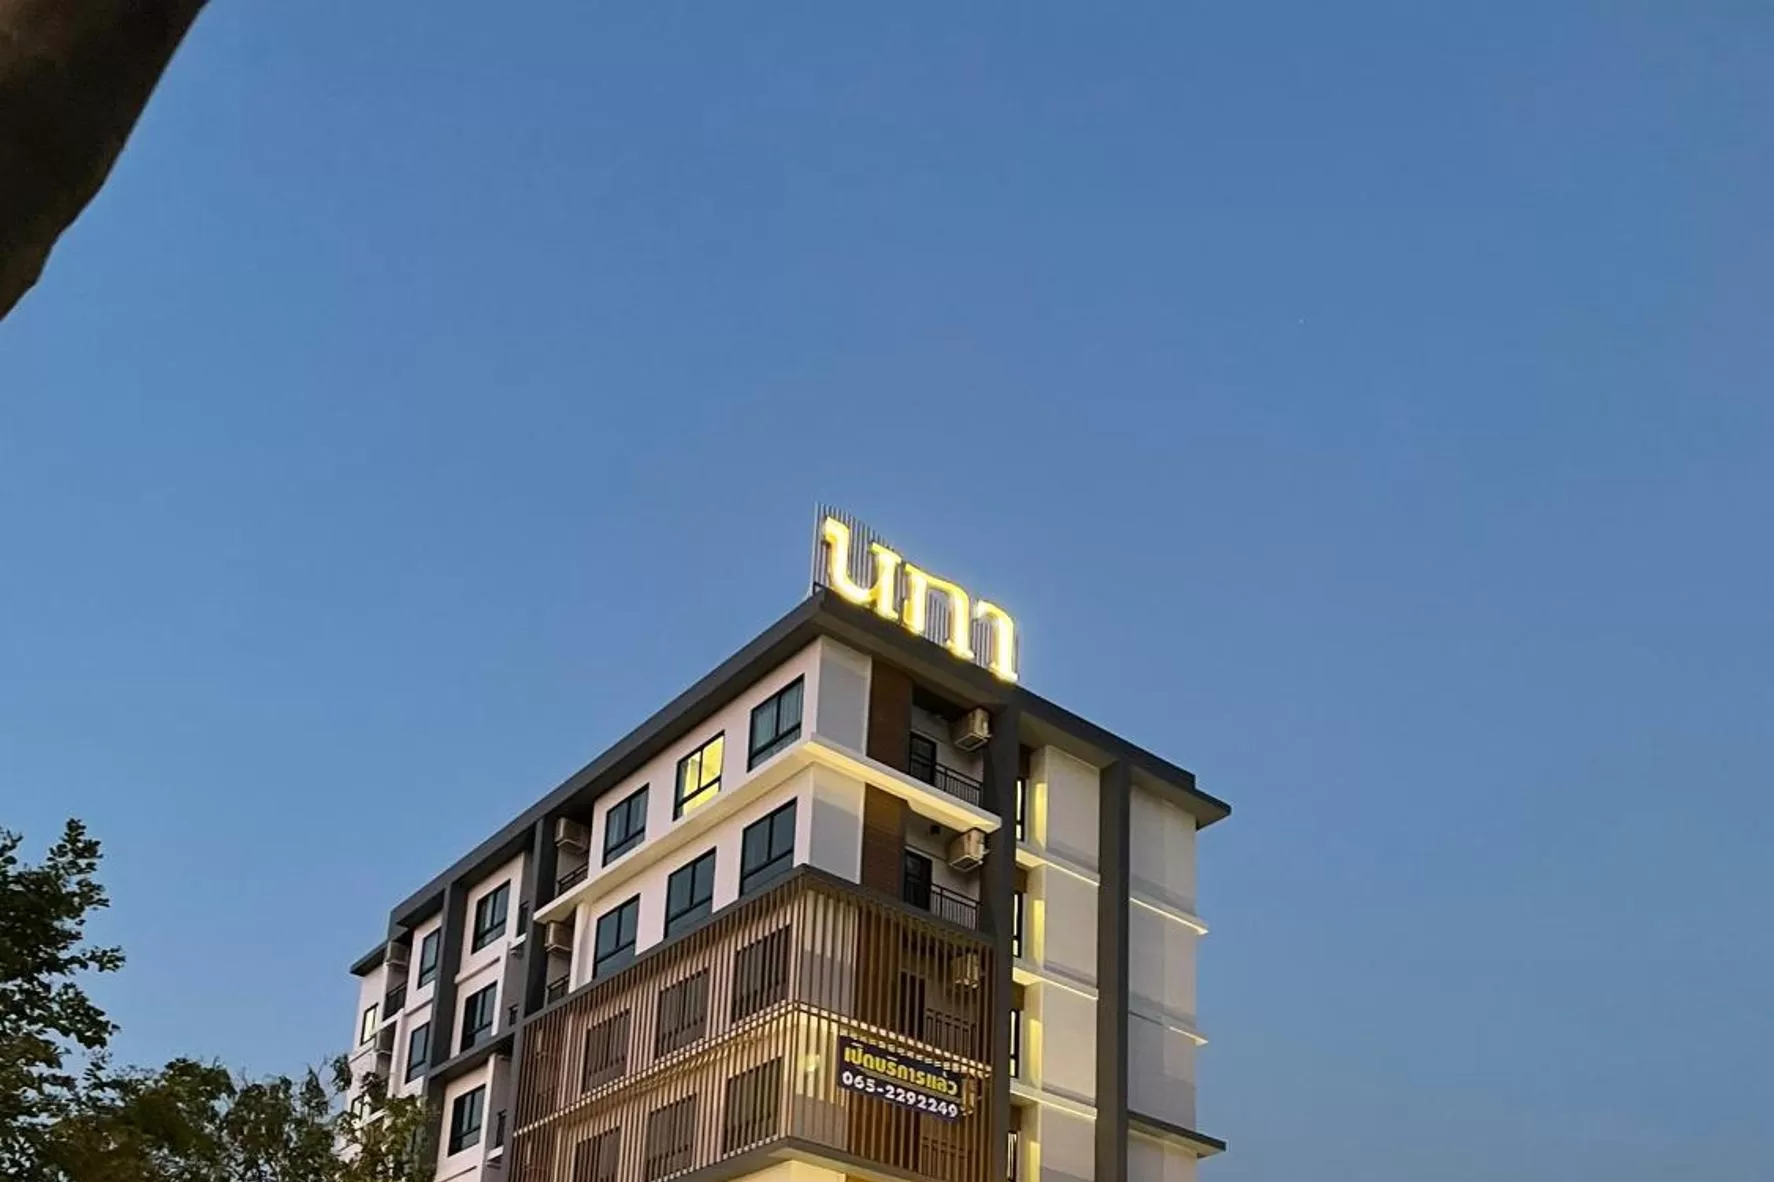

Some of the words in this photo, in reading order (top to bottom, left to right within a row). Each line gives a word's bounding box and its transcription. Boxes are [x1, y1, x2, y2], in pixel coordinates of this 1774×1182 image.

[842, 1070, 959, 1118] 065-2292249
[843, 1041, 958, 1096] เปิดบริการแล้ว
